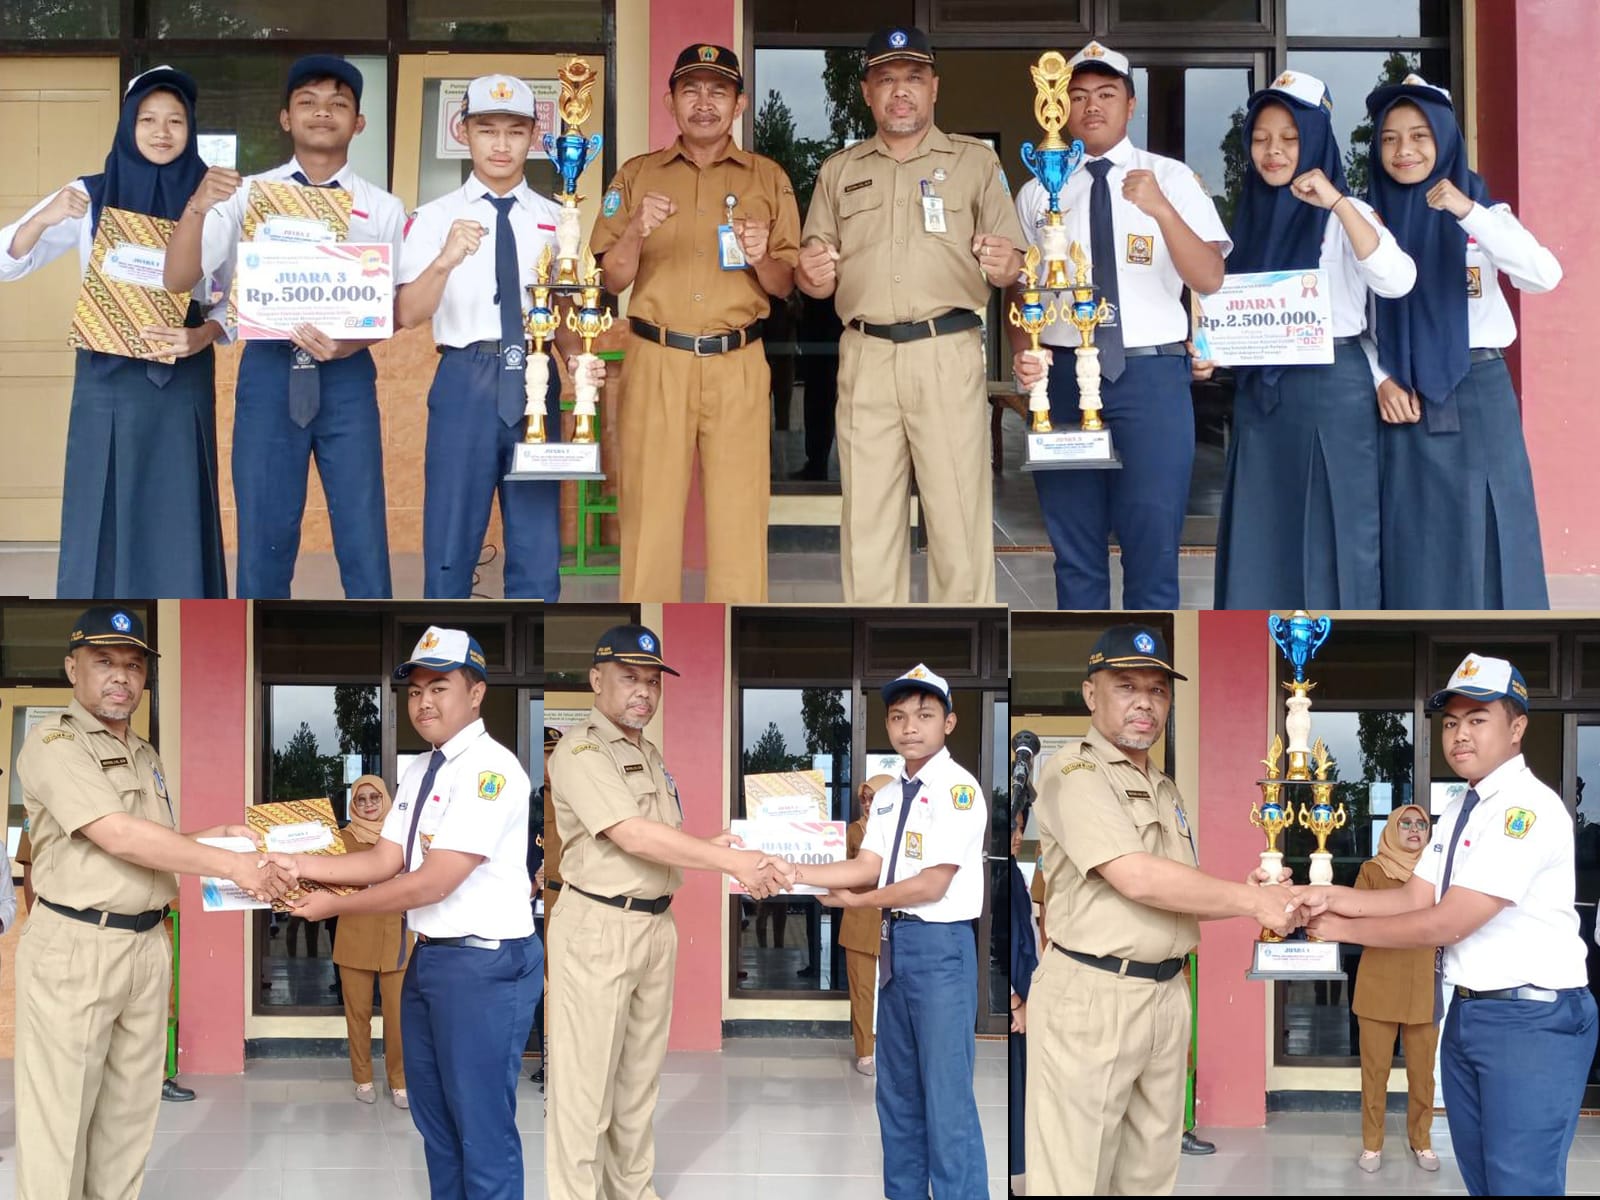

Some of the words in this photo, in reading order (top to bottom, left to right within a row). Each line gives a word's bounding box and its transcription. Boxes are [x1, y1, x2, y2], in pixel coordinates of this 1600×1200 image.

[274, 272, 332, 284] JUARA
[337, 272, 347, 282] 3
[246, 286, 390, 306] Rp.500.000,-
[1226, 298, 1275, 311] JUARA
[1280, 298, 1286, 308] 1
[1198, 311, 1328, 332] Rp.2.500.000,-
